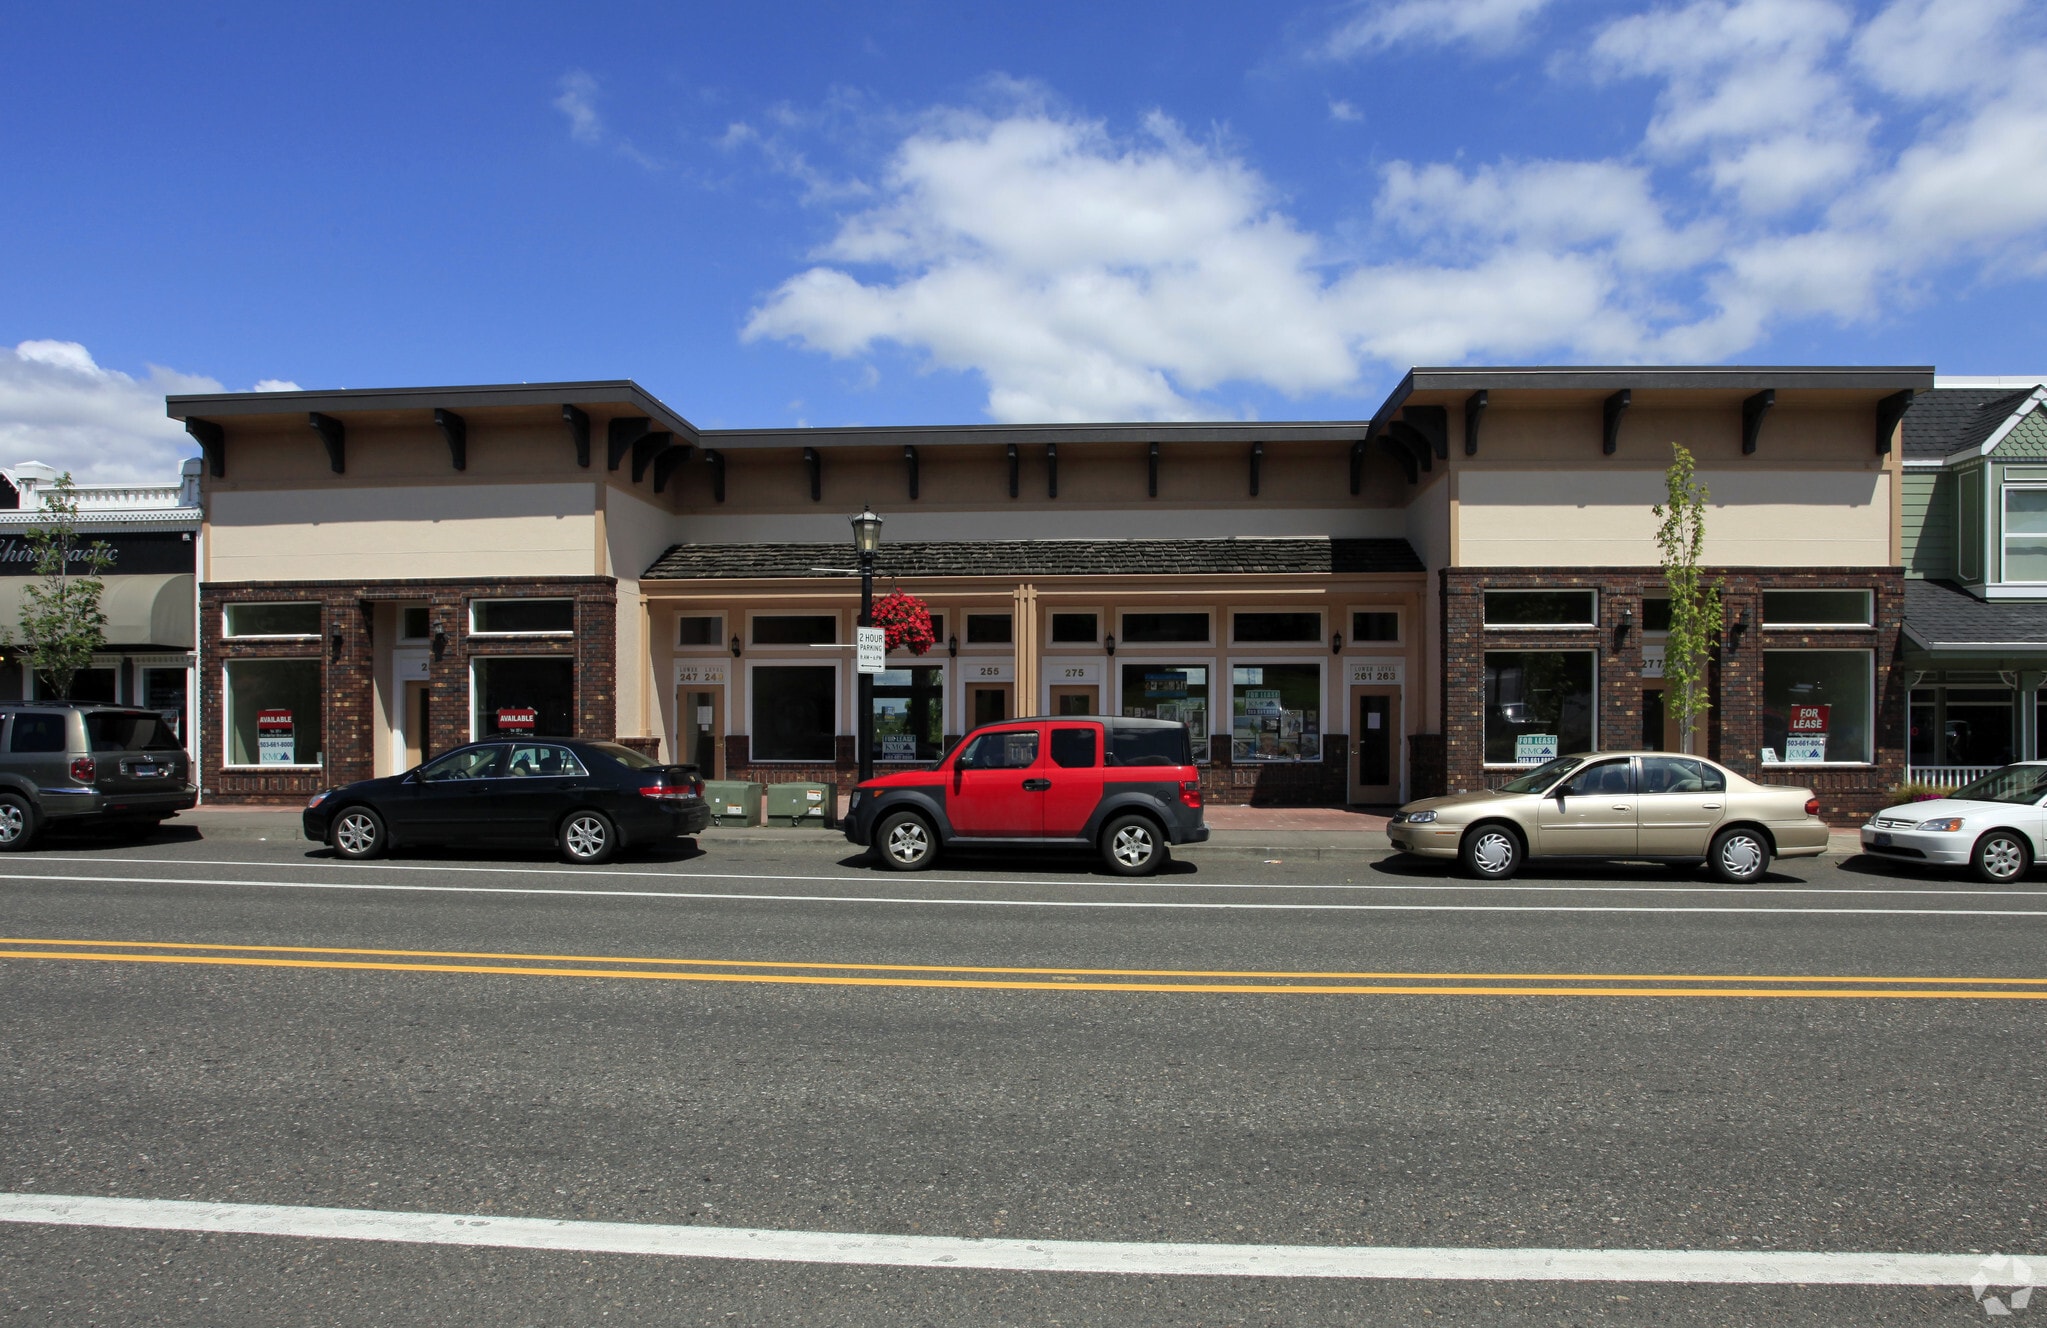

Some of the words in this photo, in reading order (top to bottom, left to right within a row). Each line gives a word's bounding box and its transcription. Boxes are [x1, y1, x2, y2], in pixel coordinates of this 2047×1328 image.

[860, 633, 864, 642] 2
[865, 634, 883, 643] HOUR
[860, 644, 882, 652] PARKING
[980, 667, 1000, 676] 255
[1065, 669, 1084, 677] 275
[680, 673, 698, 681] 247
[1354, 672, 1372, 681] 261
[1376, 672, 1396, 681] 263
[1247, 690, 1259, 698] FOR
[1261, 690, 1279, 698] LEASE
[1800, 708, 1818, 717] FOR
[500, 714, 534, 722] AVAILABLE
[1793, 720, 1823, 729] LEASE
[1519, 737, 1532, 745] FOR
[1534, 736, 1555, 745] LEASE
